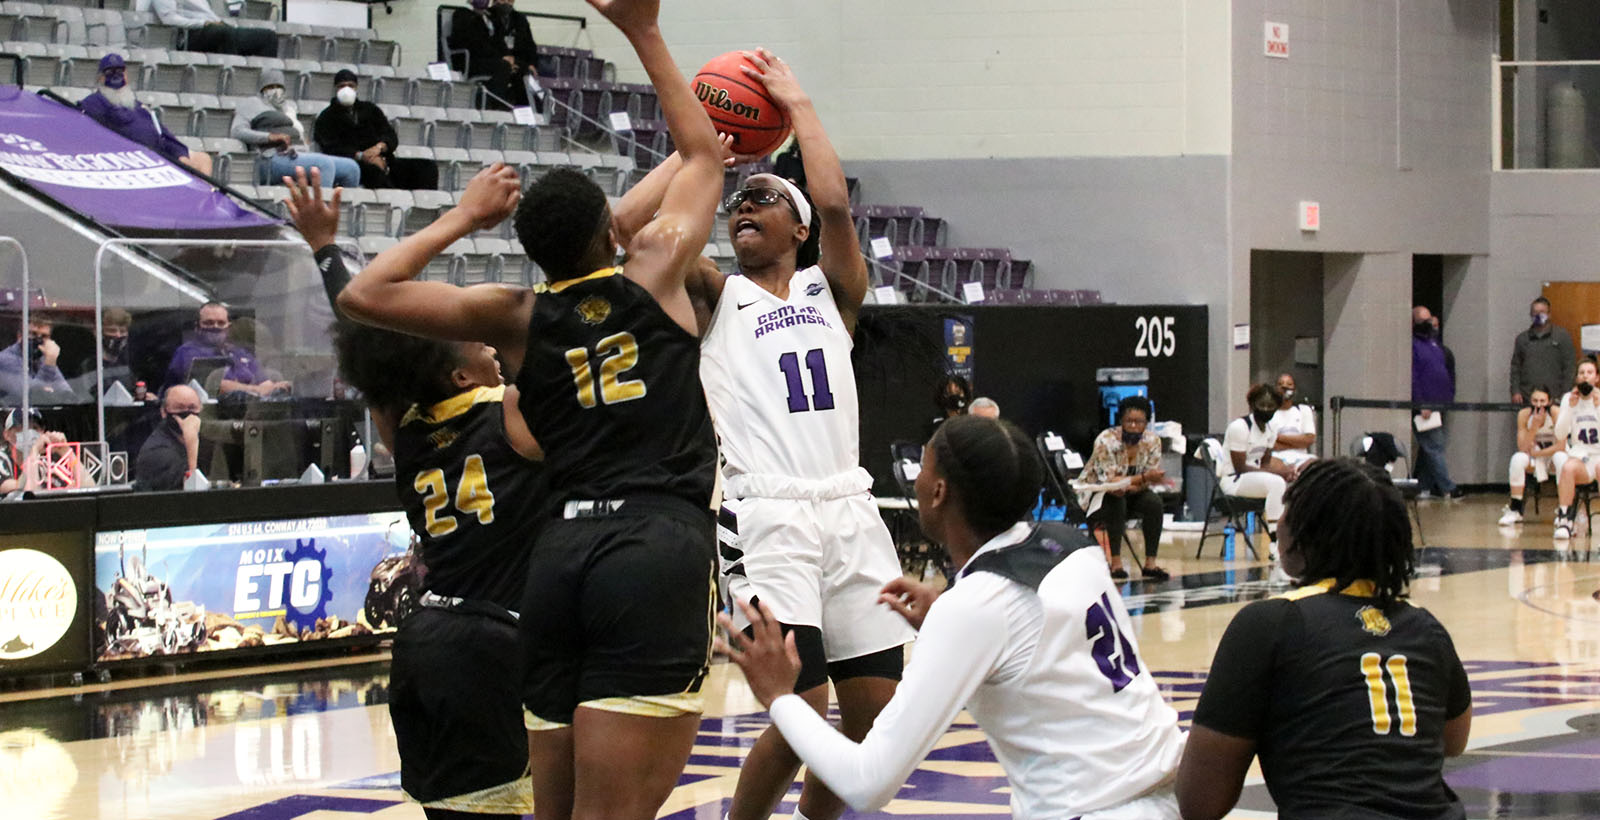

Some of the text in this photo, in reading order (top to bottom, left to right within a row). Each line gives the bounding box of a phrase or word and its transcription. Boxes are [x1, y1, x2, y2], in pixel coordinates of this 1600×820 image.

[695, 81, 760, 121] Wilson
[1134, 315, 1176, 358] 205
[565, 331, 647, 409] 12
[778, 348, 835, 414] 11
[1578, 427, 1599, 445] 42
[413, 453, 495, 538] 24
[239, 547, 284, 566] MOIX
[233, 559, 322, 612] ETC
[1360, 652, 1417, 737] 11
